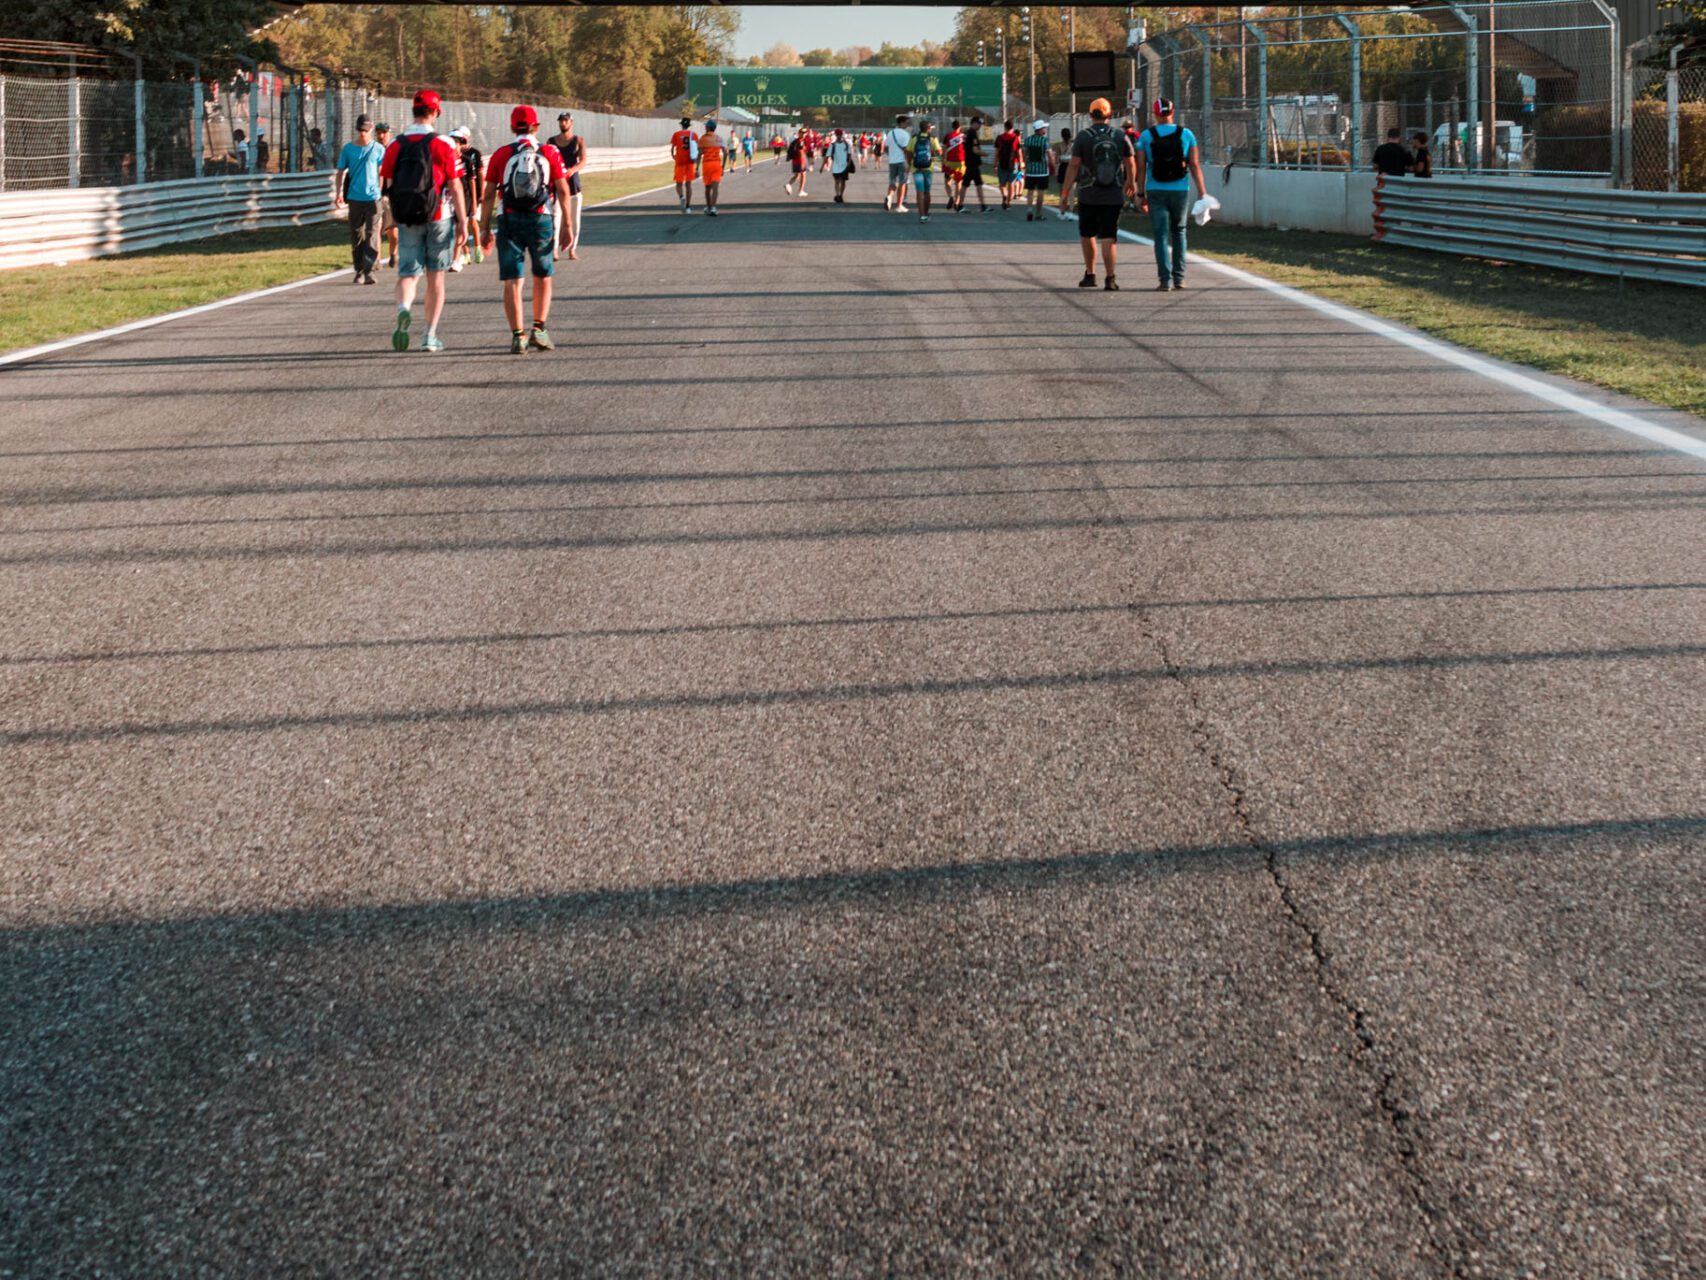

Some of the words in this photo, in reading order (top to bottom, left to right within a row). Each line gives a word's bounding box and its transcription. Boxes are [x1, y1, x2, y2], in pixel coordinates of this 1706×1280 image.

[736, 94, 787, 105] ROLEX
[821, 94, 872, 105] ROLEX
[906, 94, 957, 105] ROLEX
